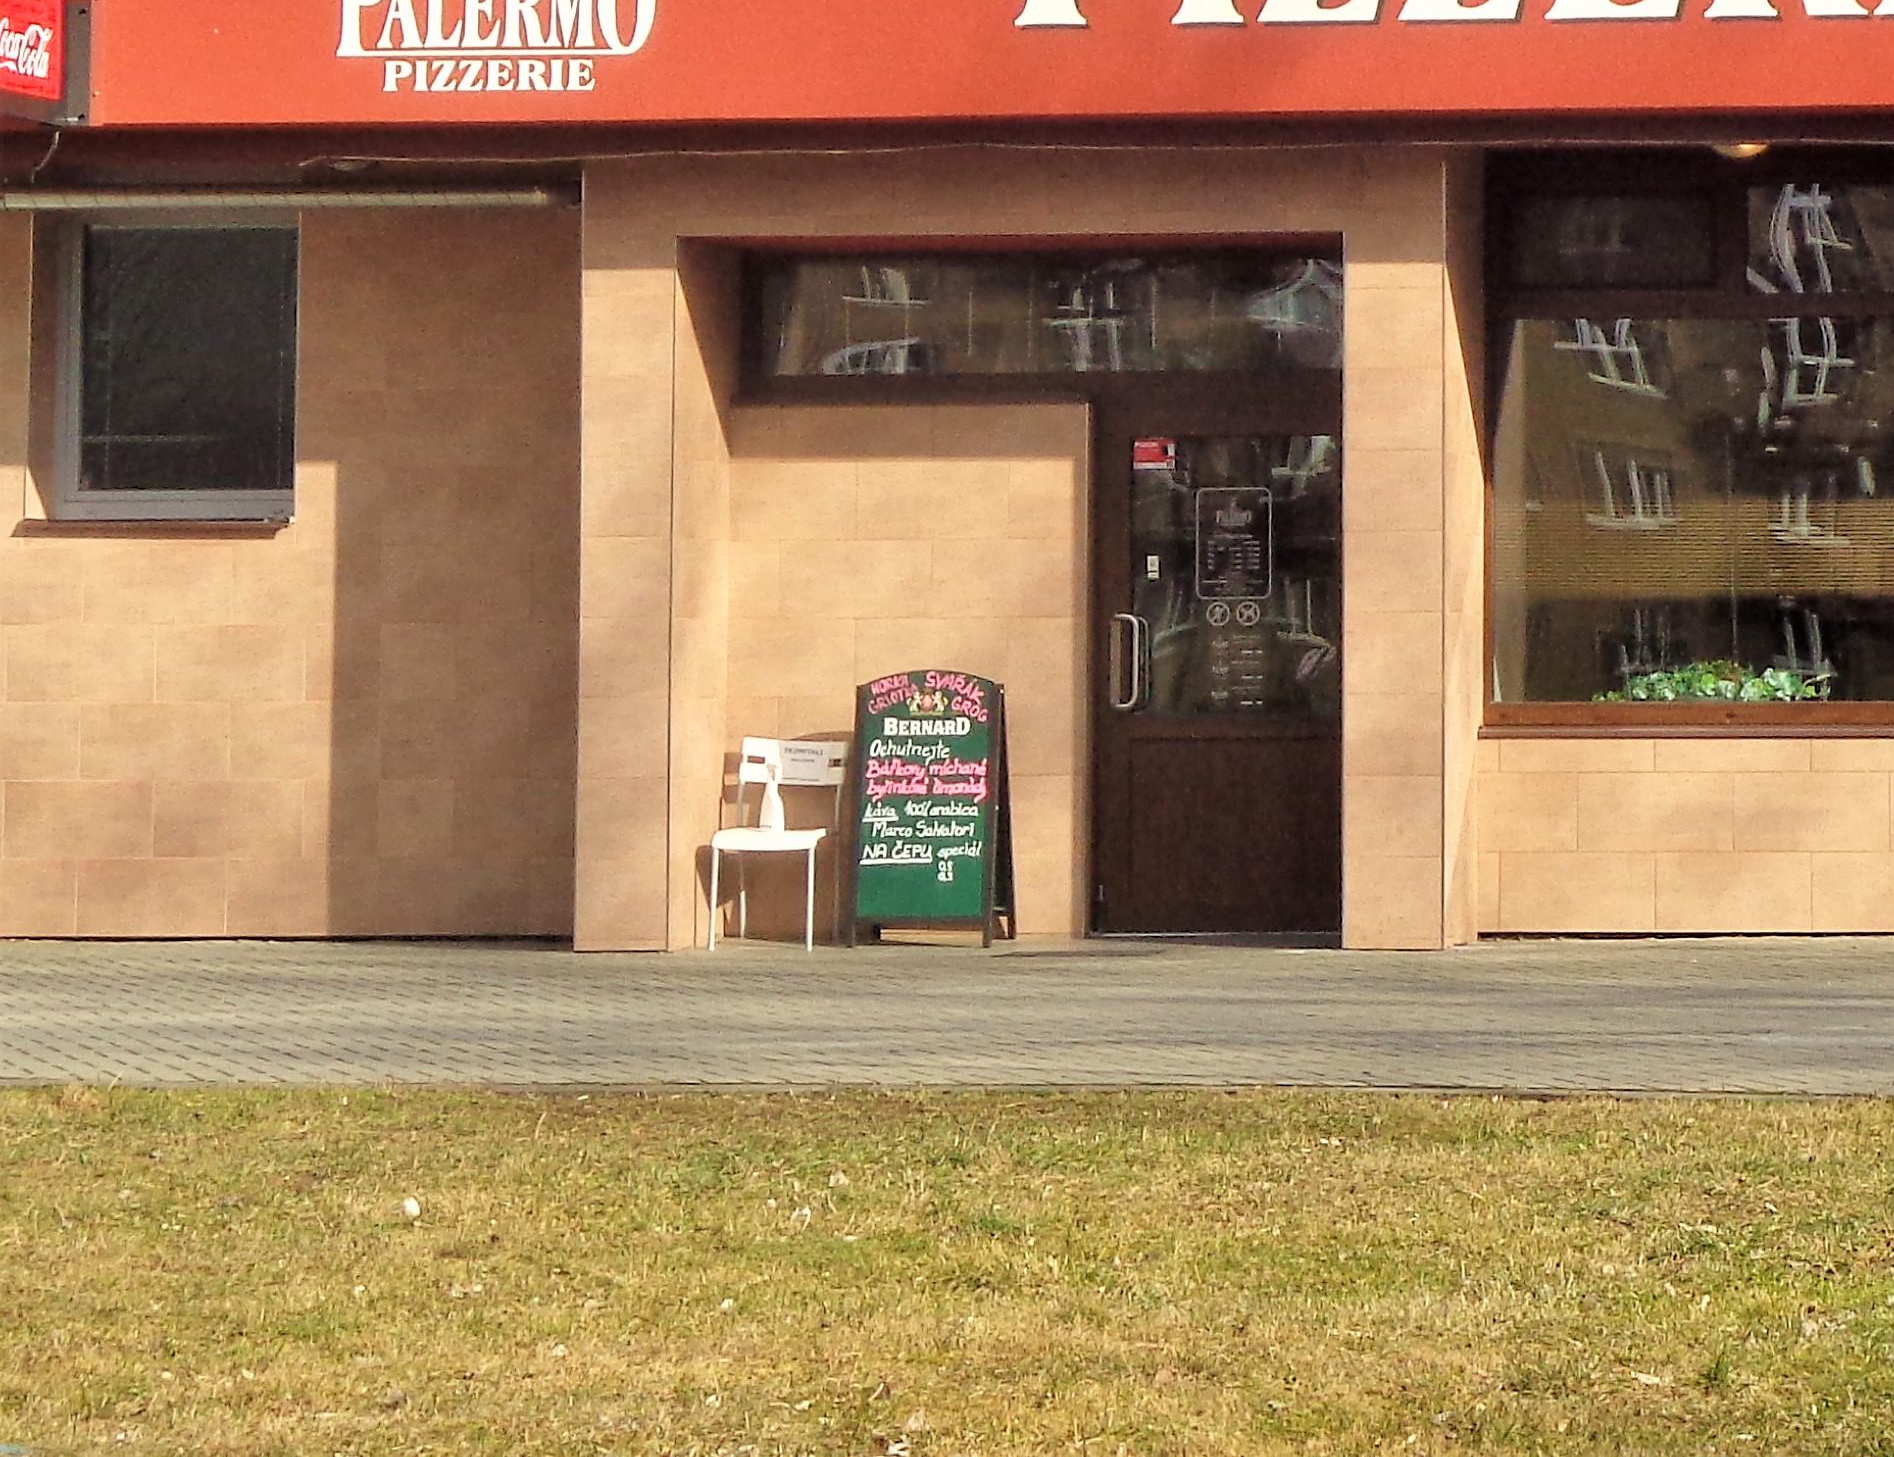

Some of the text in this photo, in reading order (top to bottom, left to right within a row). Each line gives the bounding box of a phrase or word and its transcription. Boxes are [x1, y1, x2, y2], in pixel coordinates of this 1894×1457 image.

[382, 59, 597, 93] PIZZERIE
[882, 716, 971, 736] BERNARD
[872, 821, 913, 838] Marco
[862, 843, 888, 860] NA
[891, 840, 933, 860] ČEPU
